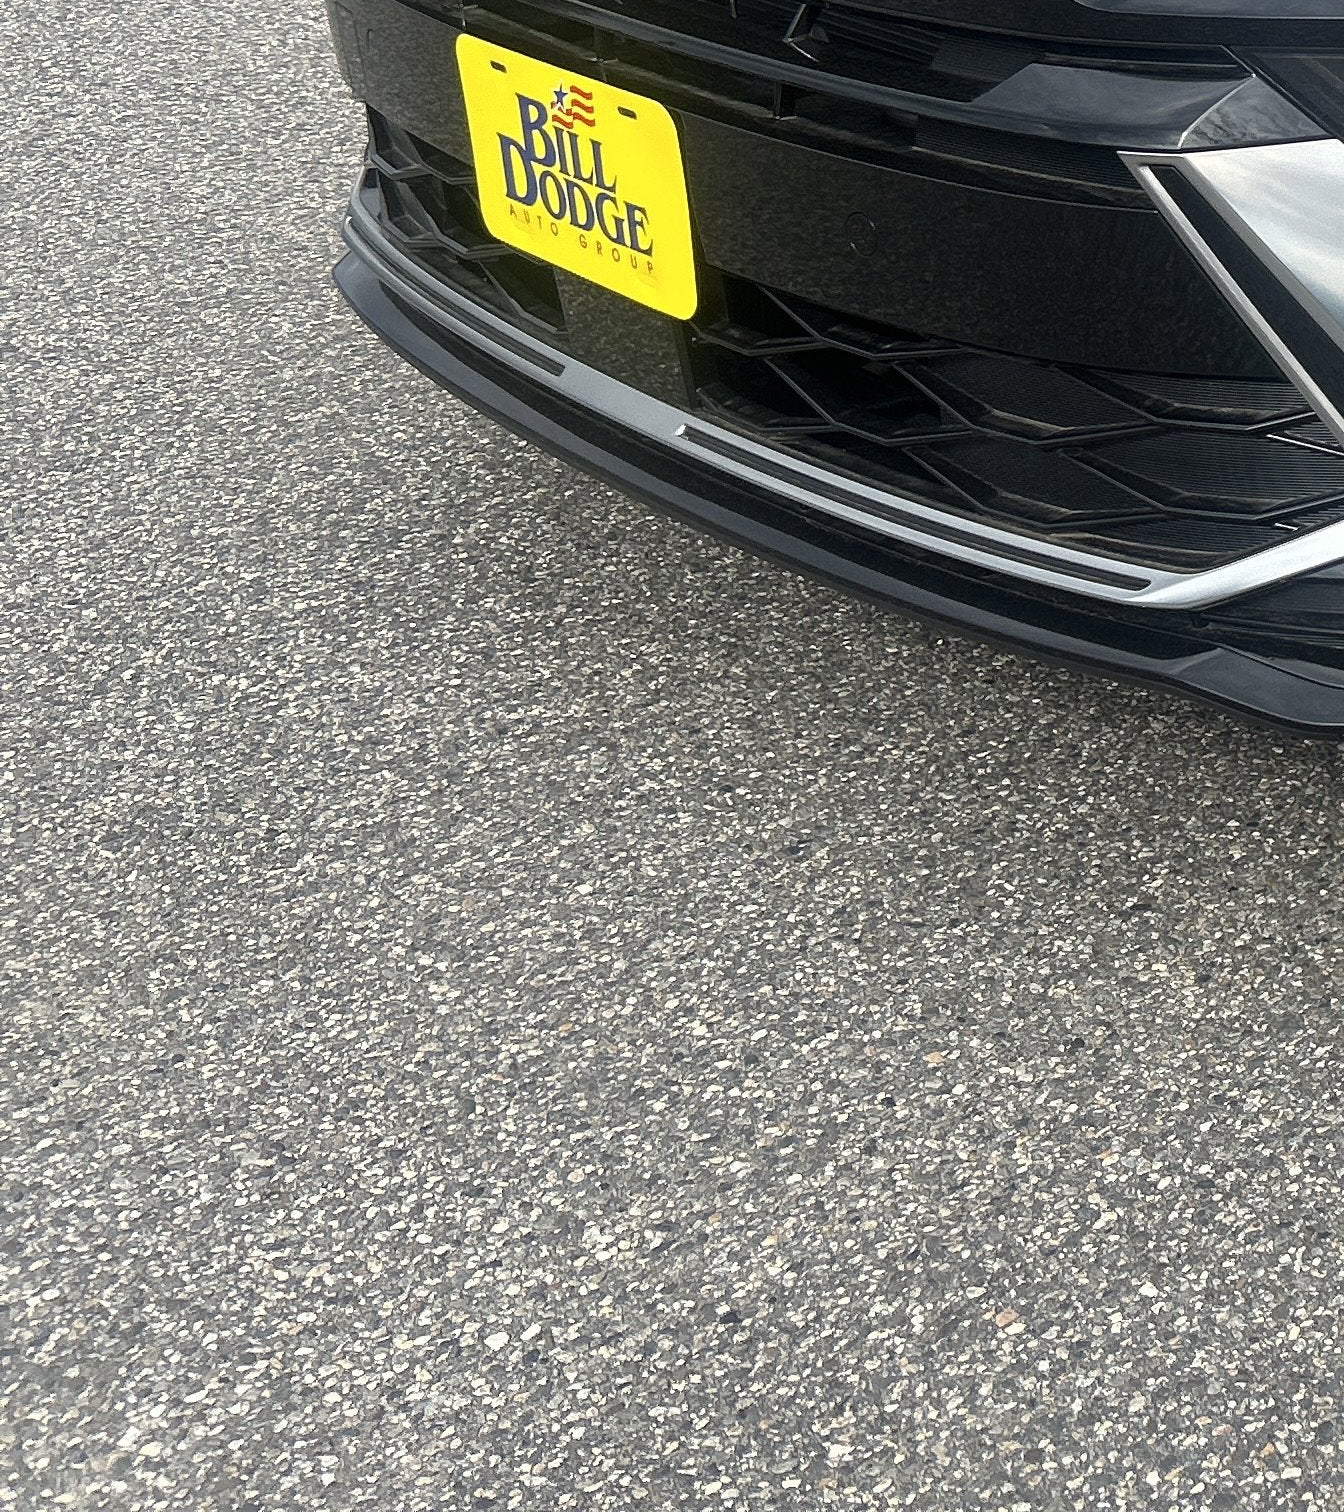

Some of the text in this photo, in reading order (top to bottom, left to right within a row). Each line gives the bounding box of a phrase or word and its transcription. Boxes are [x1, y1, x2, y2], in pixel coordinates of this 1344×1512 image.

[515, 92, 617, 193] BILL
[496, 131, 653, 258] DODGE
[509, 203, 653, 274] AUTO GROUP
